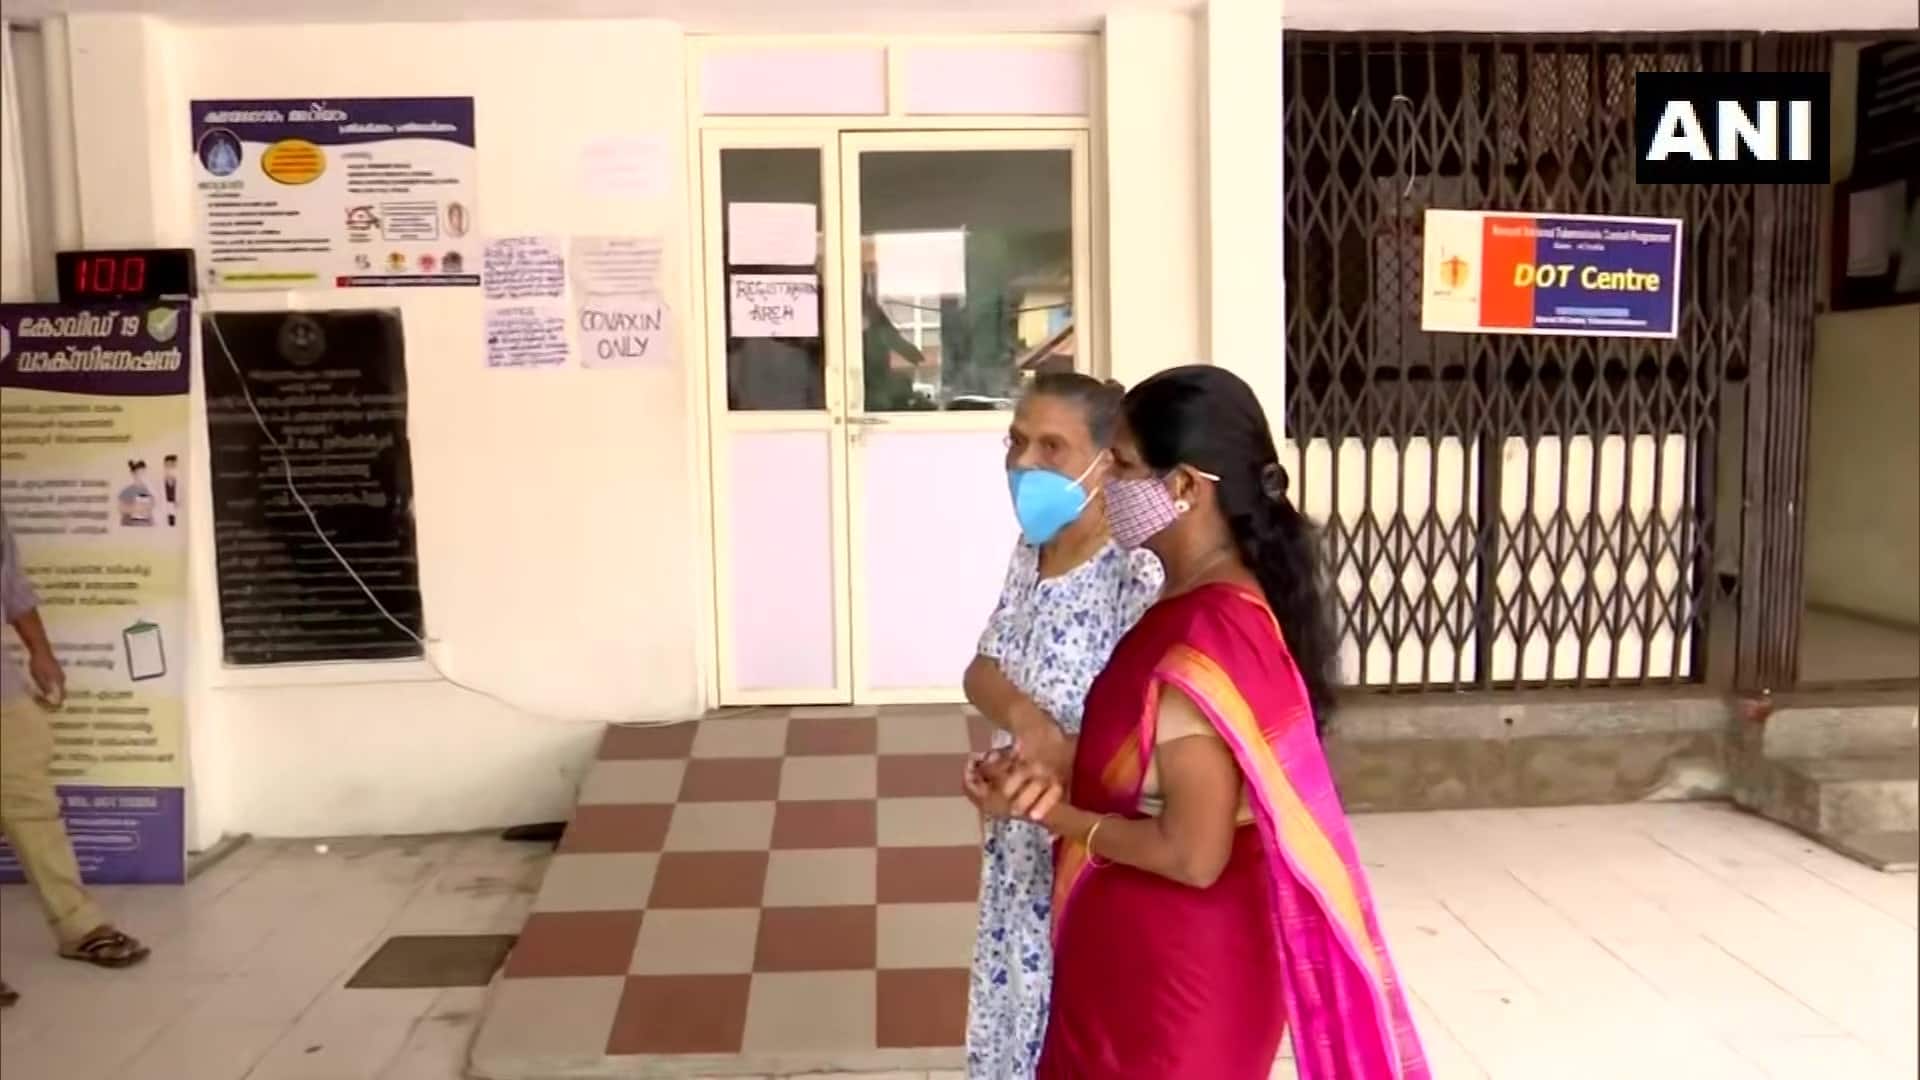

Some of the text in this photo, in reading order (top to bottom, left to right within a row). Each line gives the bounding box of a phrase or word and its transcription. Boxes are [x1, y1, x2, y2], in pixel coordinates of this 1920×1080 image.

[1514, 263, 1660, 292] DOT Centre
[18, 310, 140, 338] കോവിഡ് 19
[580, 307, 661, 332] COVAXIN
[749, 304, 795, 322] AREA
[598, 336, 649, 360] ONLY
